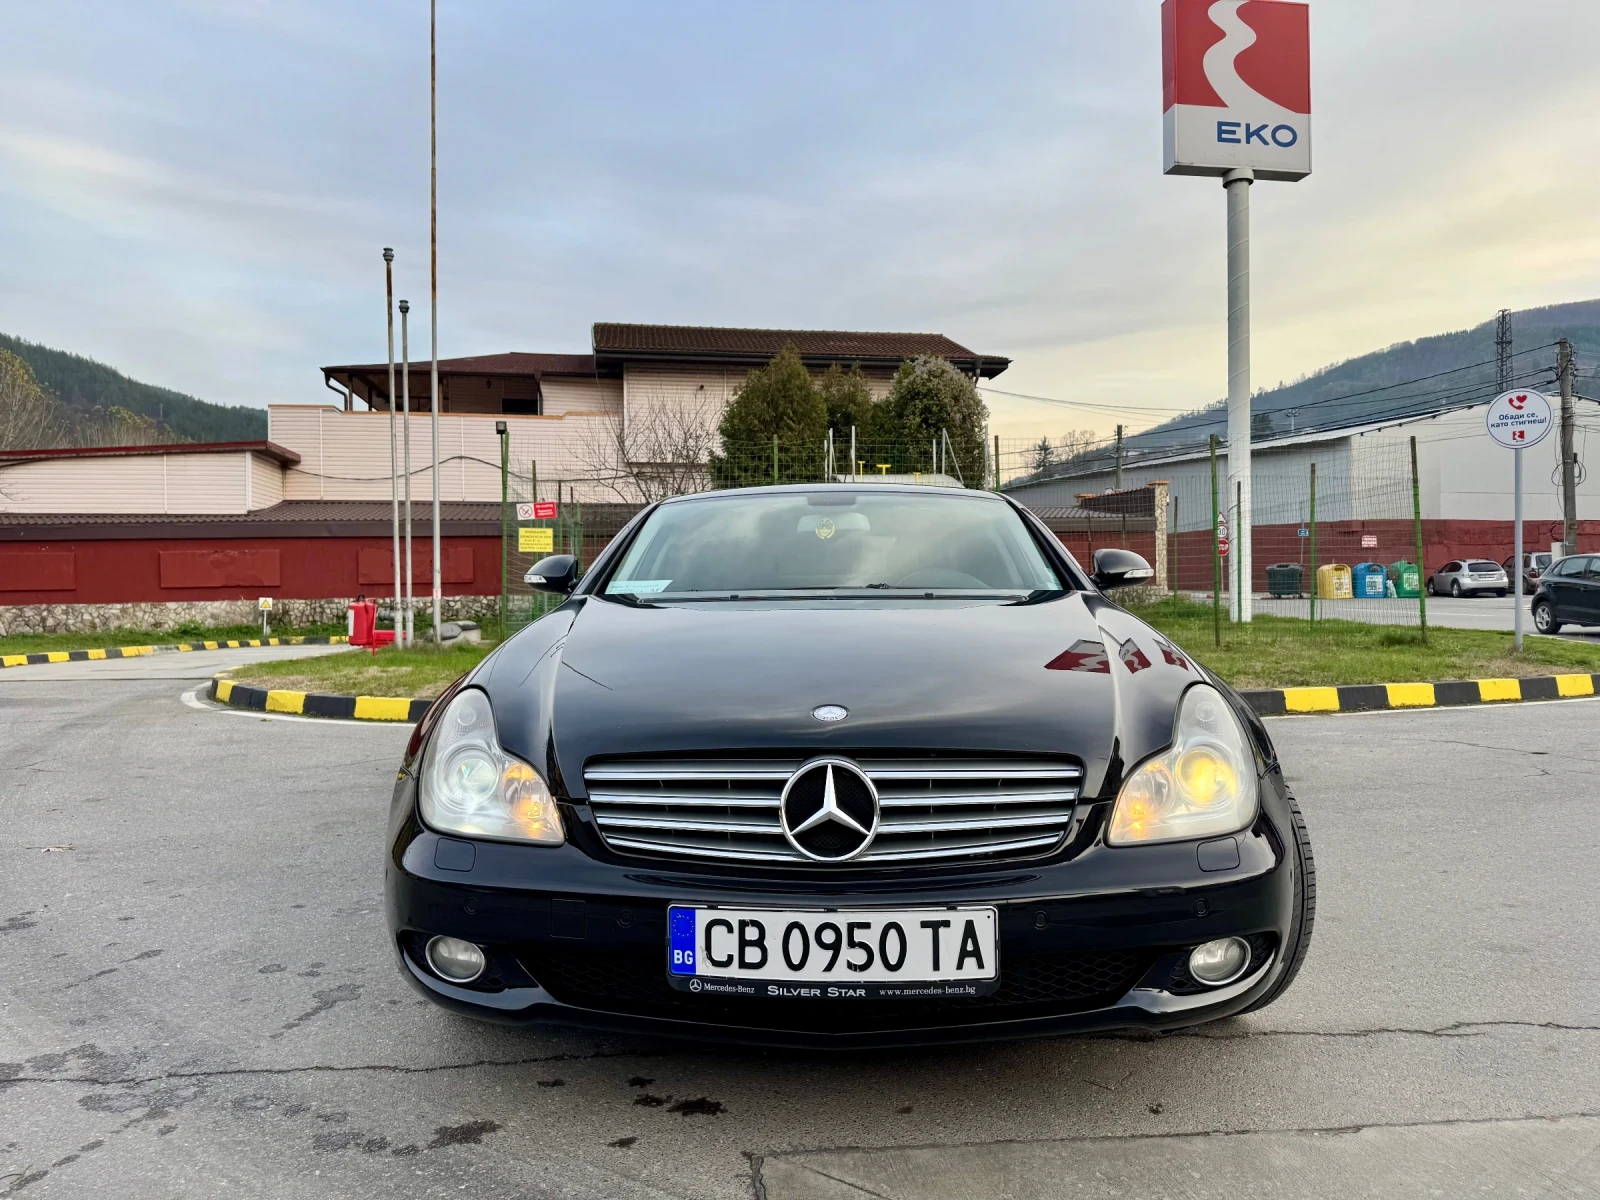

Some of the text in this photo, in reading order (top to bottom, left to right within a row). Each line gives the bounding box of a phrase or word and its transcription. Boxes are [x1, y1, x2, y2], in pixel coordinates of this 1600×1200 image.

[1216, 120, 1298, 148] EKO
[1510, 417, 1547, 426] стигнеш!
[705, 919, 985, 972] CB 0950 TA
[673, 949, 694, 965] BG
[703, 982, 755, 994] Mercedes-Benz
[879, 984, 976, 996] www.mercedes-benz.bg
